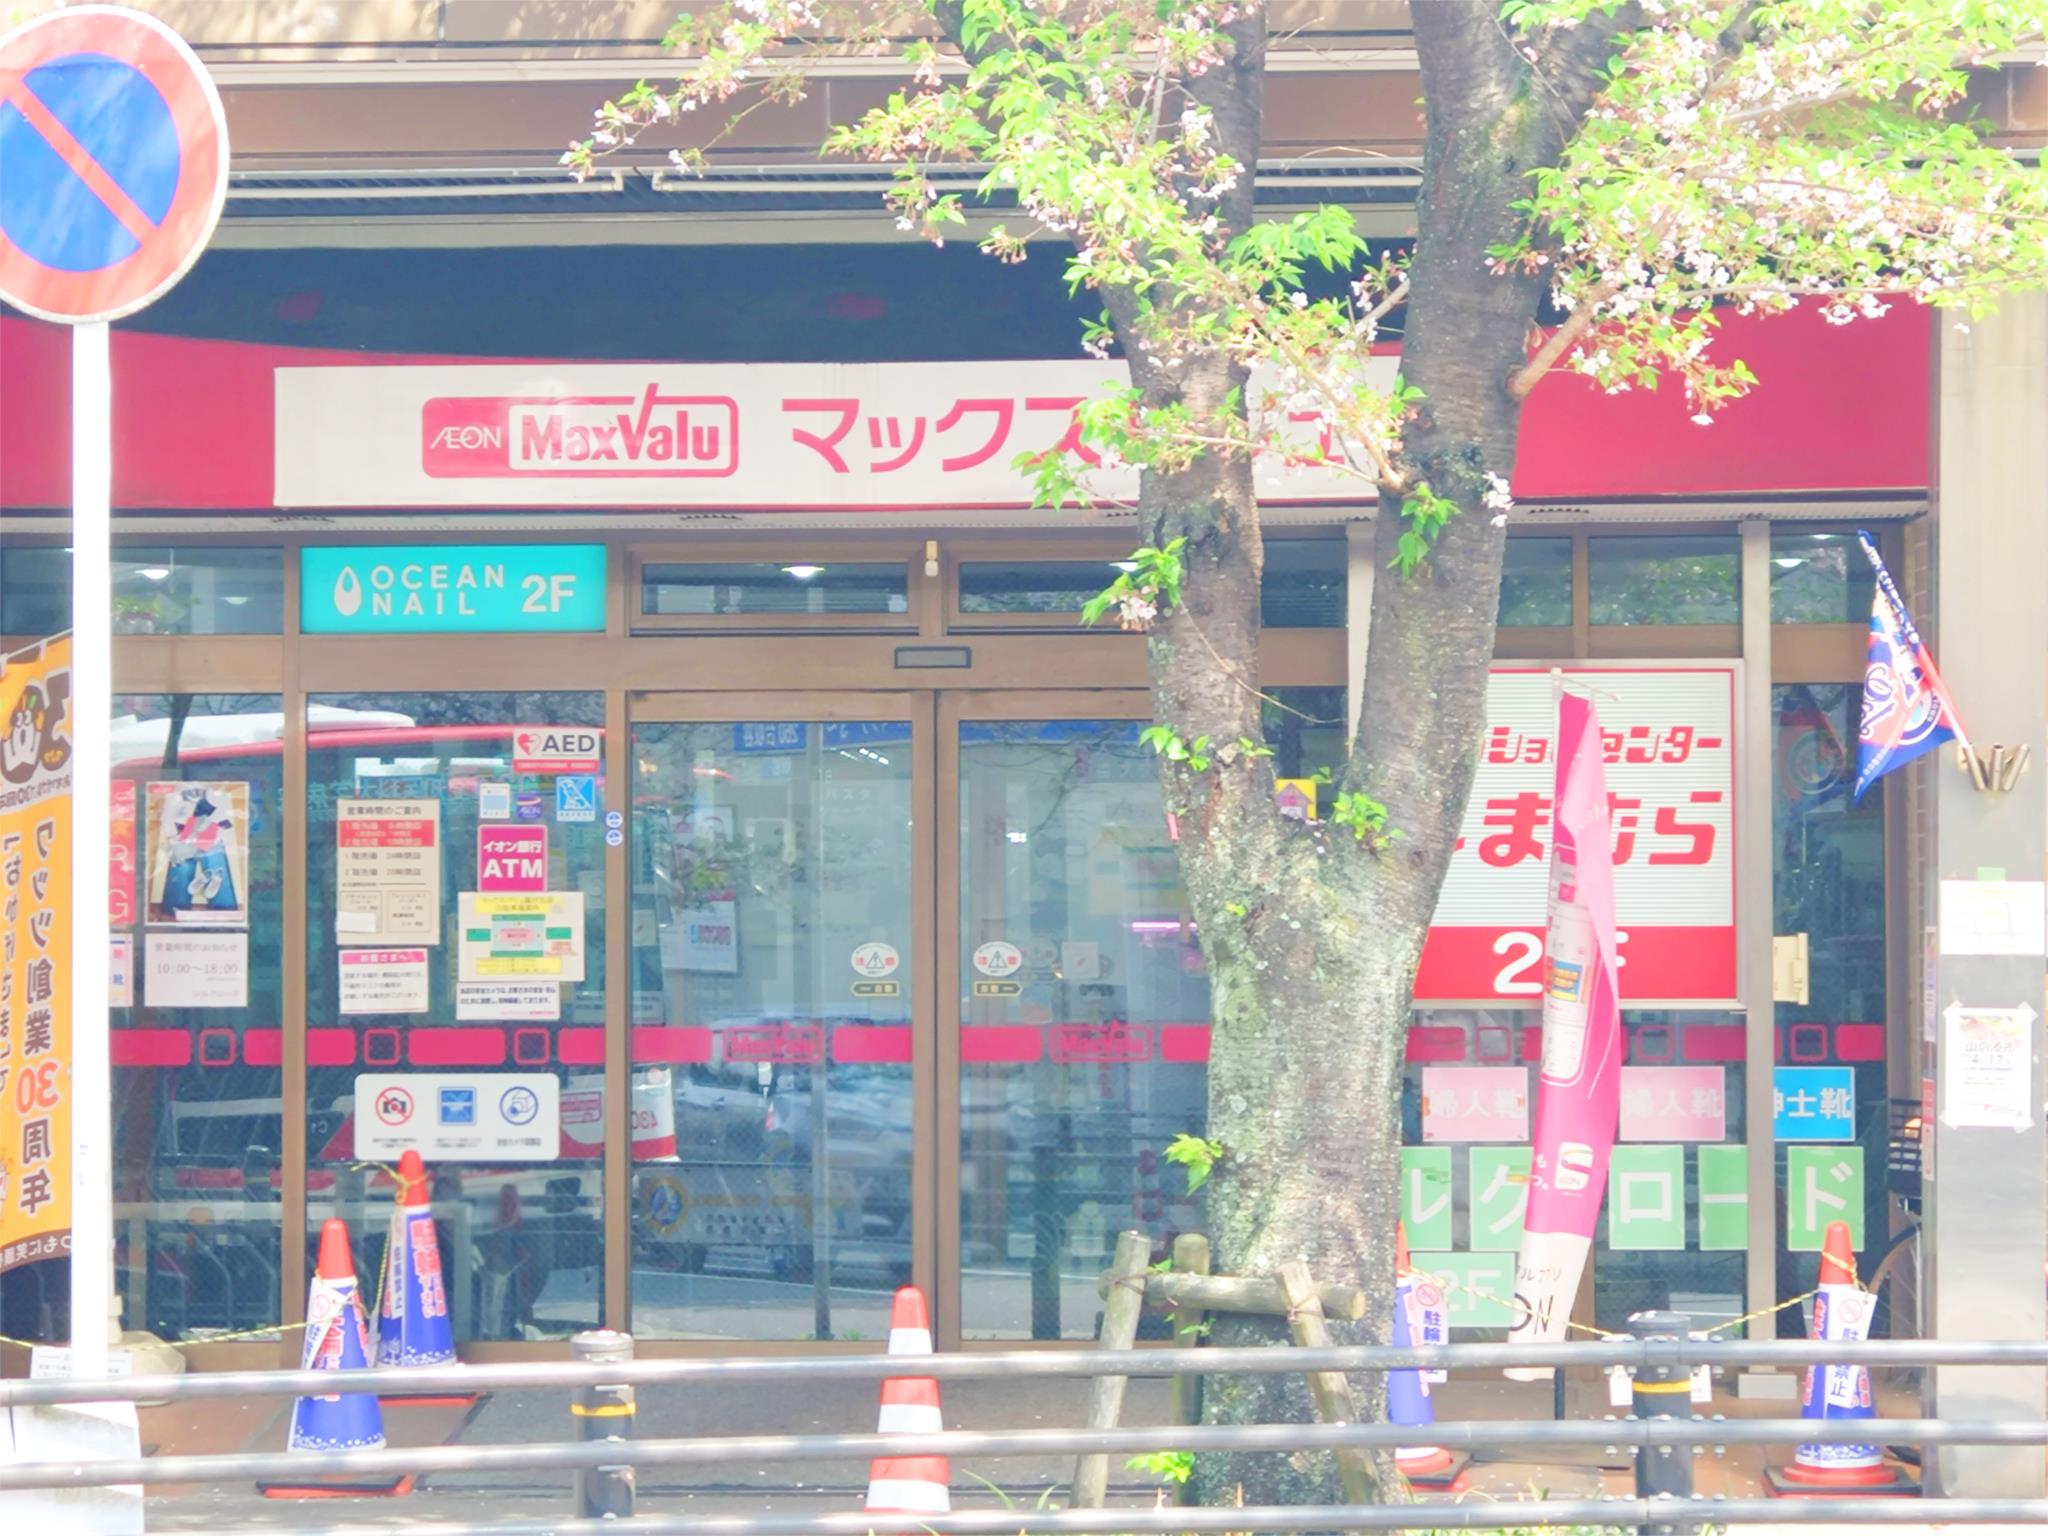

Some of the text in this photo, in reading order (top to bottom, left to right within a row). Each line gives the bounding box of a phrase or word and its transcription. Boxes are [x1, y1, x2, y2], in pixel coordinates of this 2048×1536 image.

[521, 383, 720, 462] MaxValu
[370, 564, 505, 590] OCEAN
[371, 591, 476, 616] NAIL
[519, 574, 577, 613] 2F
[542, 734, 596, 753] AED
[483, 840, 543, 854] イオン銀行
[482, 858, 543, 878] ATM
[360, 953, 408, 963] お客さまへ
[1622, 1087, 1723, 1119] 婦人靴
